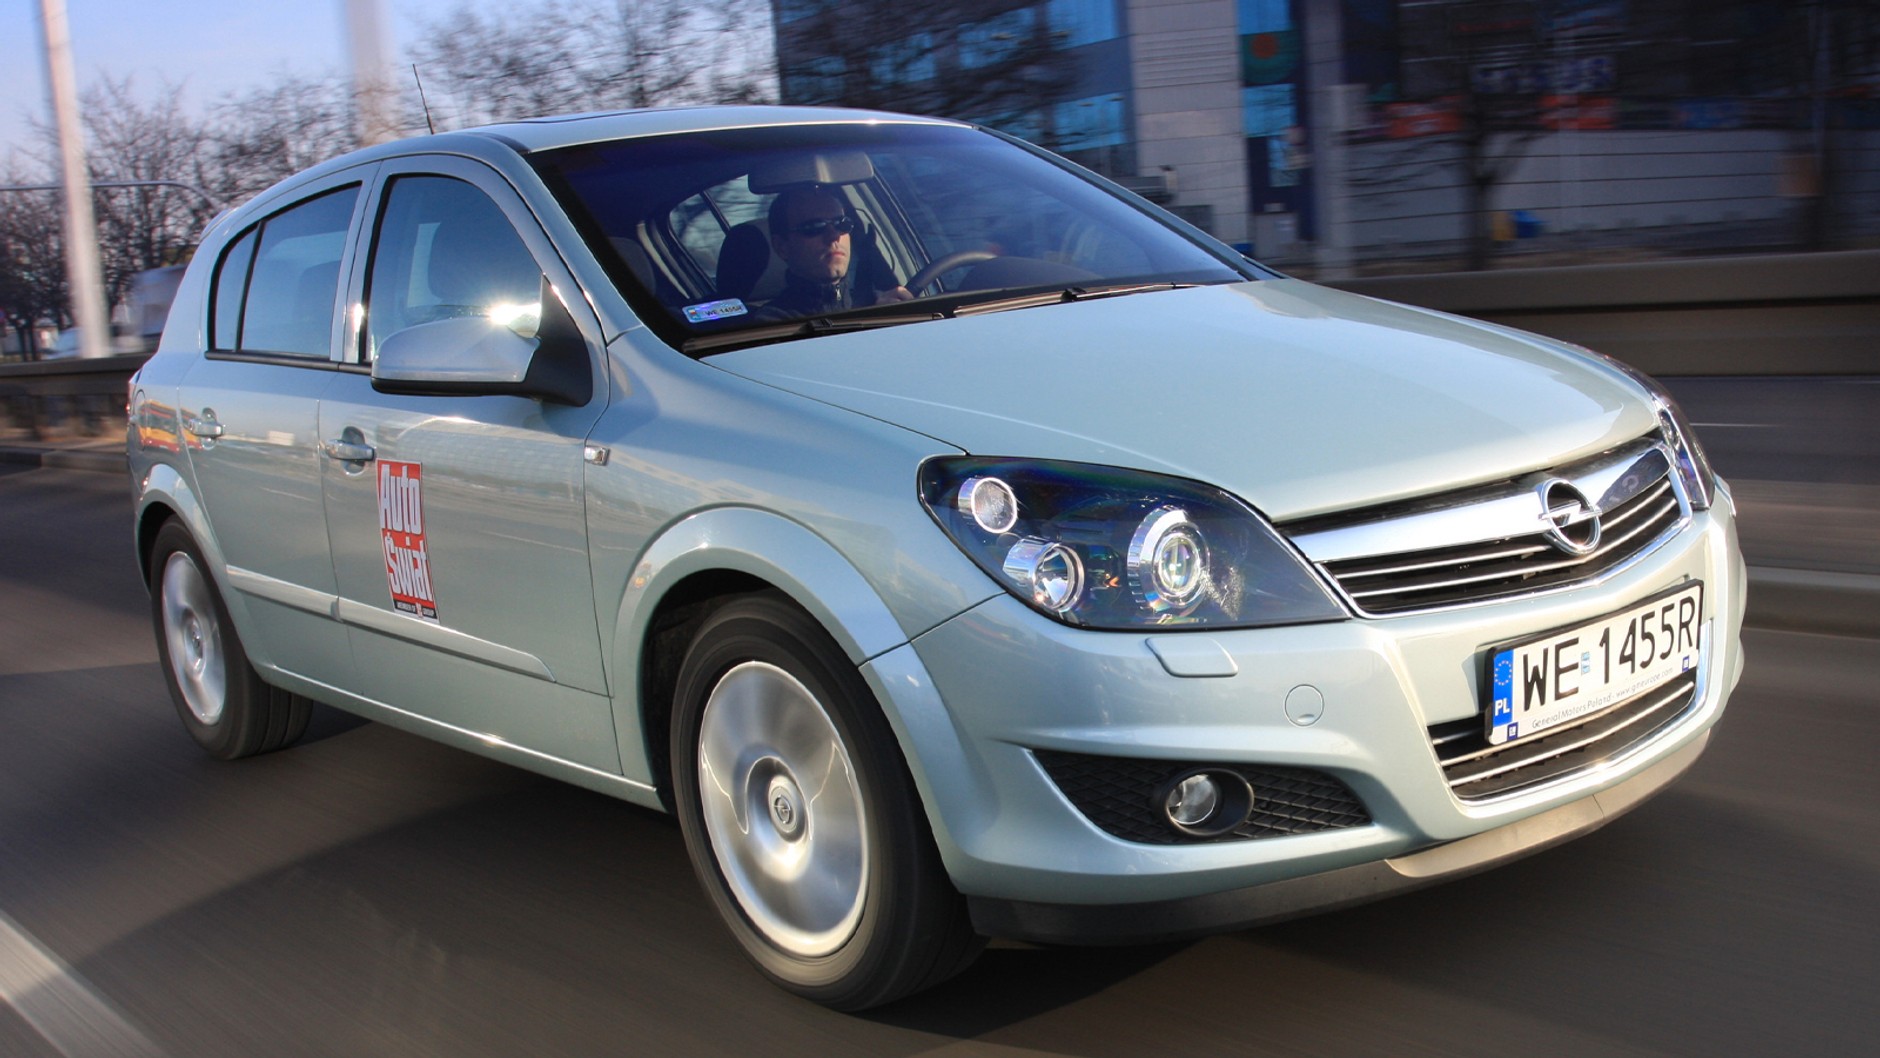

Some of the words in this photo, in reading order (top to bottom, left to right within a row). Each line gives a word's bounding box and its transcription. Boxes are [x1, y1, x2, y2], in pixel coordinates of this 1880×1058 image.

[380, 464, 422, 535] Auto
[385, 532, 433, 602] Świat
[1522, 636, 1580, 712] WE
[1599, 596, 1696, 685] 1455R
[1495, 697, 1510, 716] PL
[1532, 711, 1560, 729] General
[1561, 704, 1586, 718] Motors
[1587, 692, 1611, 709] Poland
